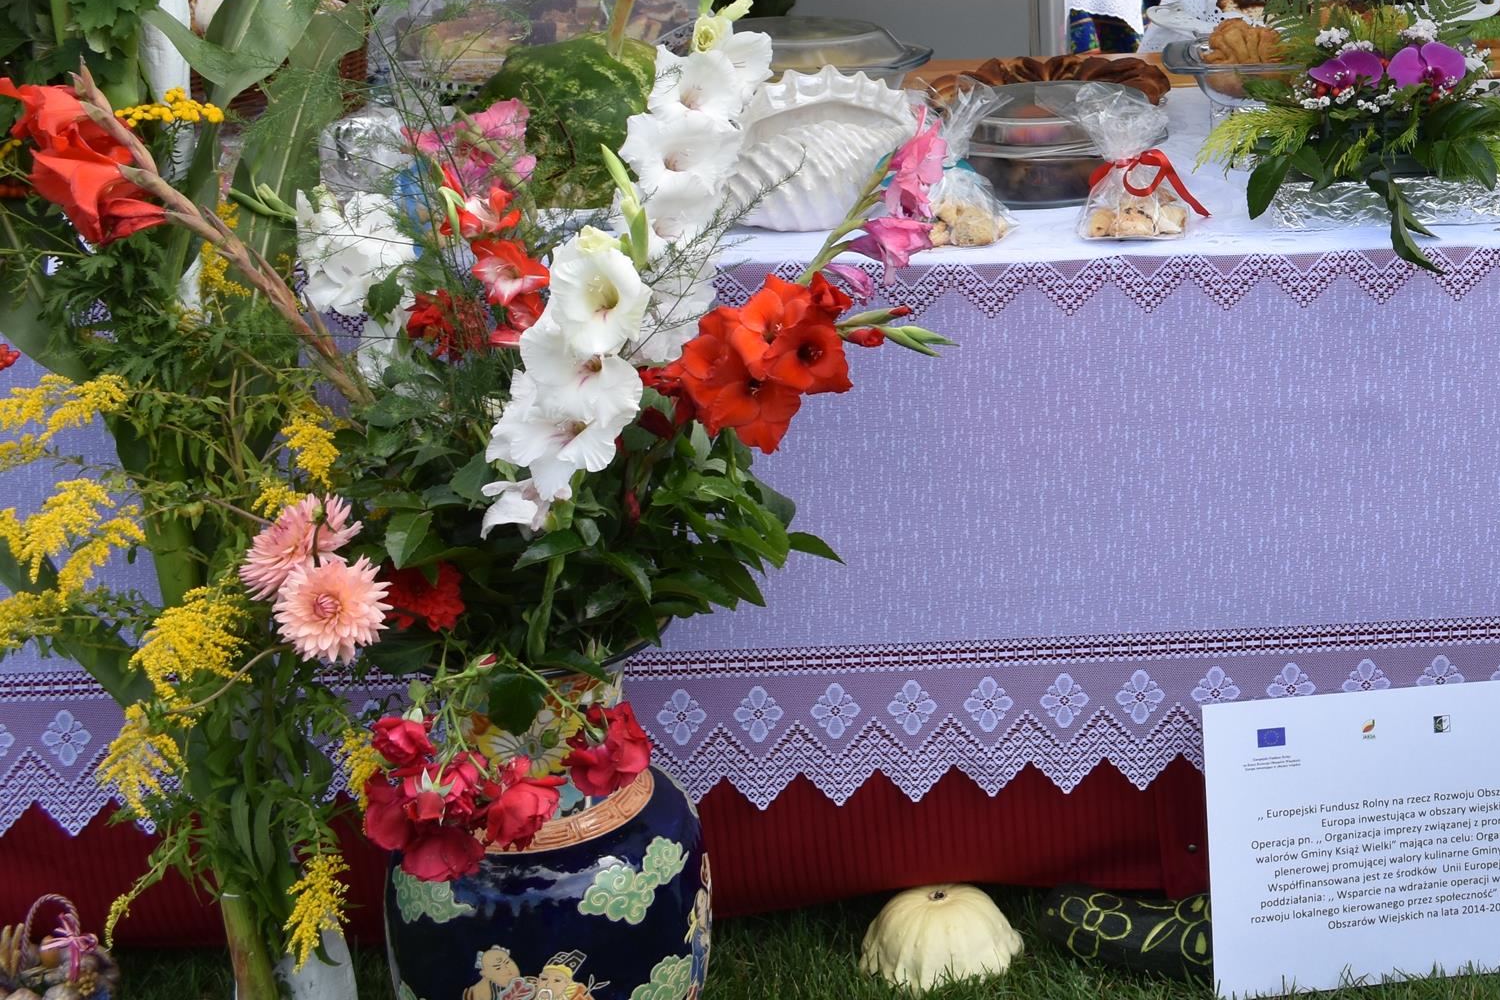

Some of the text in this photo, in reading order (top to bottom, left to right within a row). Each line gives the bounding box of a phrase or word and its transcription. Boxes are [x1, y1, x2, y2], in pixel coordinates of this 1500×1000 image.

[1266, 804, 1317, 818] Europejski
[1320, 801, 1360, 813] Fundusz
[1362, 798, 1389, 809] Rolny
[1392, 798, 1404, 806] na
[1406, 795, 1431, 804] rzecz
[1434, 790, 1474, 801] Rozwoju
[1321, 817, 1356, 828] Europa
[1358, 810, 1416, 824] inwestująca
[1417, 810, 1427, 818] w
[1429, 806, 1466, 817] obszary
[1251, 837, 1295, 851] Operacja
[1298, 837, 1313, 847] pn.
[1324, 827, 1381, 843] Organizacja
[1383, 825, 1422, 837] imprezy
[1424, 818, 1471, 834] związanej
[1473, 819, 1479, 827] z
[1255, 851, 1298, 864] walorów
[1300, 848, 1333, 859] Gminy
[1335, 844, 1359, 856] Książ
[1399, 838, 1433, 849] mająca
[1436, 837, 1448, 845] na
[1450, 833, 1474, 843] celu:
[1267, 875, 1360, 893] Współfinansowana
[1362, 872, 1381, 884] jest
[1382, 871, 1394, 880] ze
[1396, 865, 1437, 879] środków
[1442, 862, 1461, 873] Unii
[1274, 862, 1329, 879] plenerowej
[1332, 856, 1387, 873] promującej
[1389, 853, 1422, 864] walory
[1424, 849, 1469, 860] kulinarne
[1260, 893, 1325, 910] poddziałania:
[1336, 886, 1382, 900] Wsparcie
[1384, 886, 1396, 894] na
[1398, 878, 1448, 893] wdrażanie
[1450, 874, 1489, 888] operacji
[1251, 911, 1290, 924] rozwoju
[1292, 907, 1340, 919] lokalnego
[1342, 899, 1405, 913] kierowanego
[1407, 896, 1433, 908] przez
[1328, 916, 1376, 930] Obszarów
[1378, 910, 1424, 924] Wiejskich
[1427, 910, 1438, 918] na
[1441, 907, 1459, 917] lata
